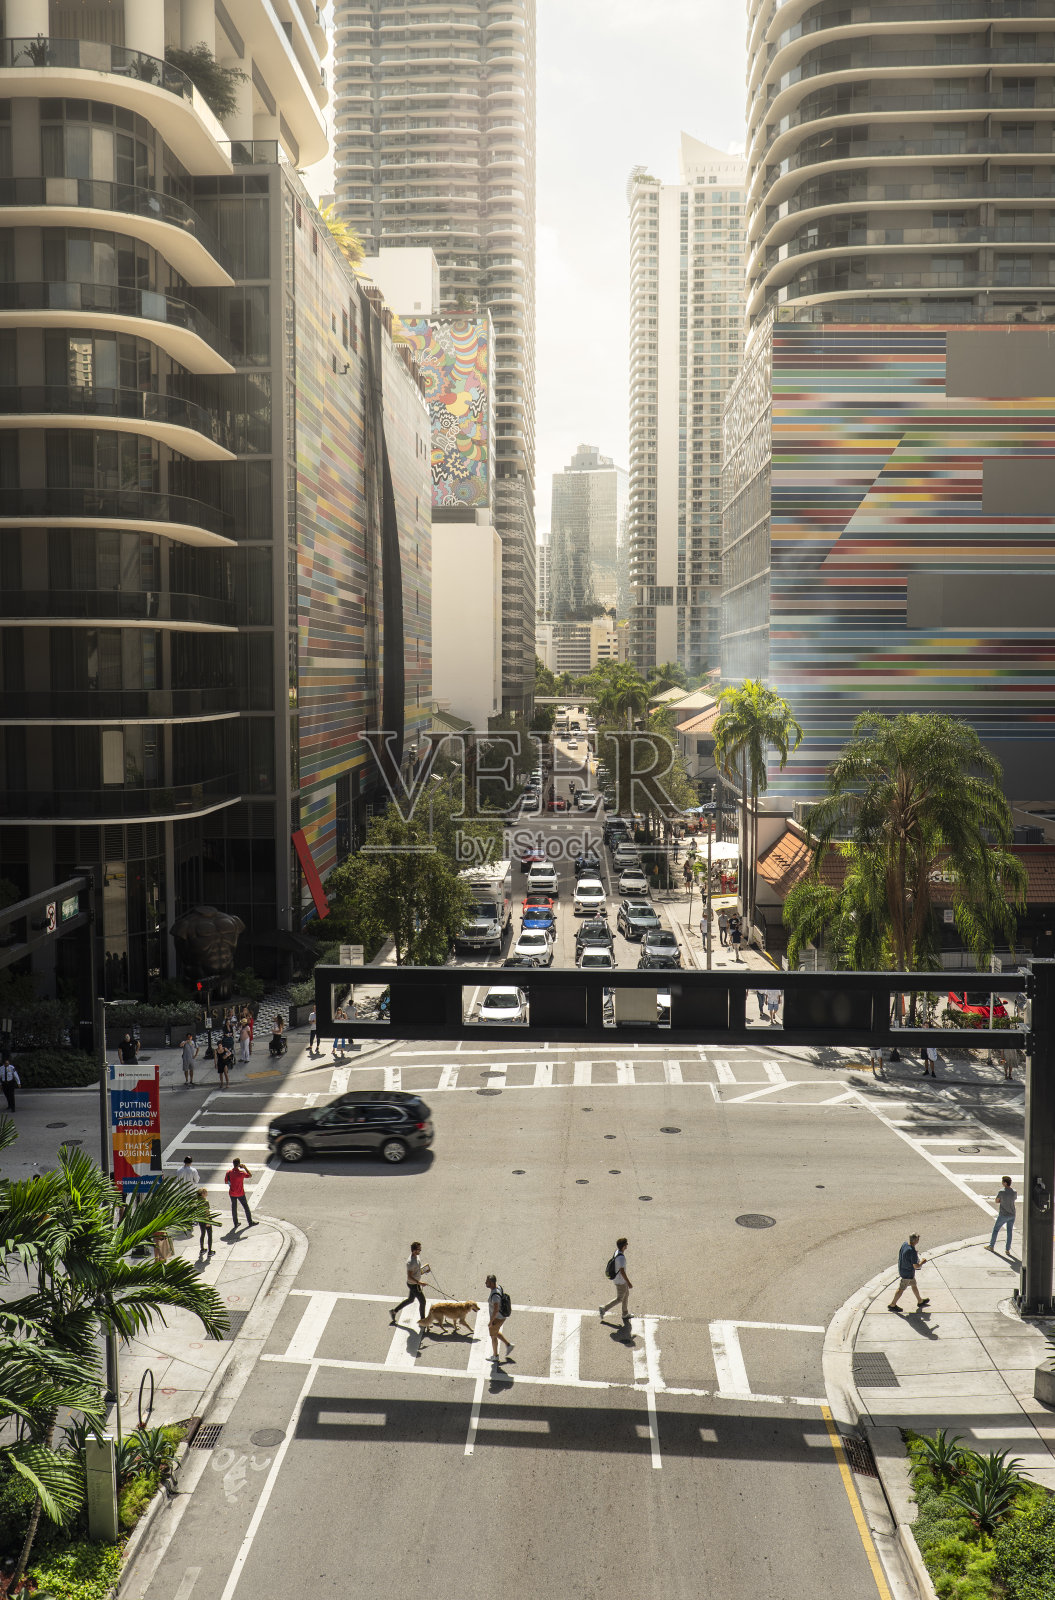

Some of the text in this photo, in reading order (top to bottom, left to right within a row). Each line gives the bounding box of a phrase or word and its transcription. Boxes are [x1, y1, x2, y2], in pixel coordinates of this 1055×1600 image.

[119, 1101, 152, 1109] PUTTING
[114, 1110, 158, 1118] TOMORROW
[118, 1119, 155, 1127] AHEAD OF
[125, 1142, 150, 1150] THAT'S
